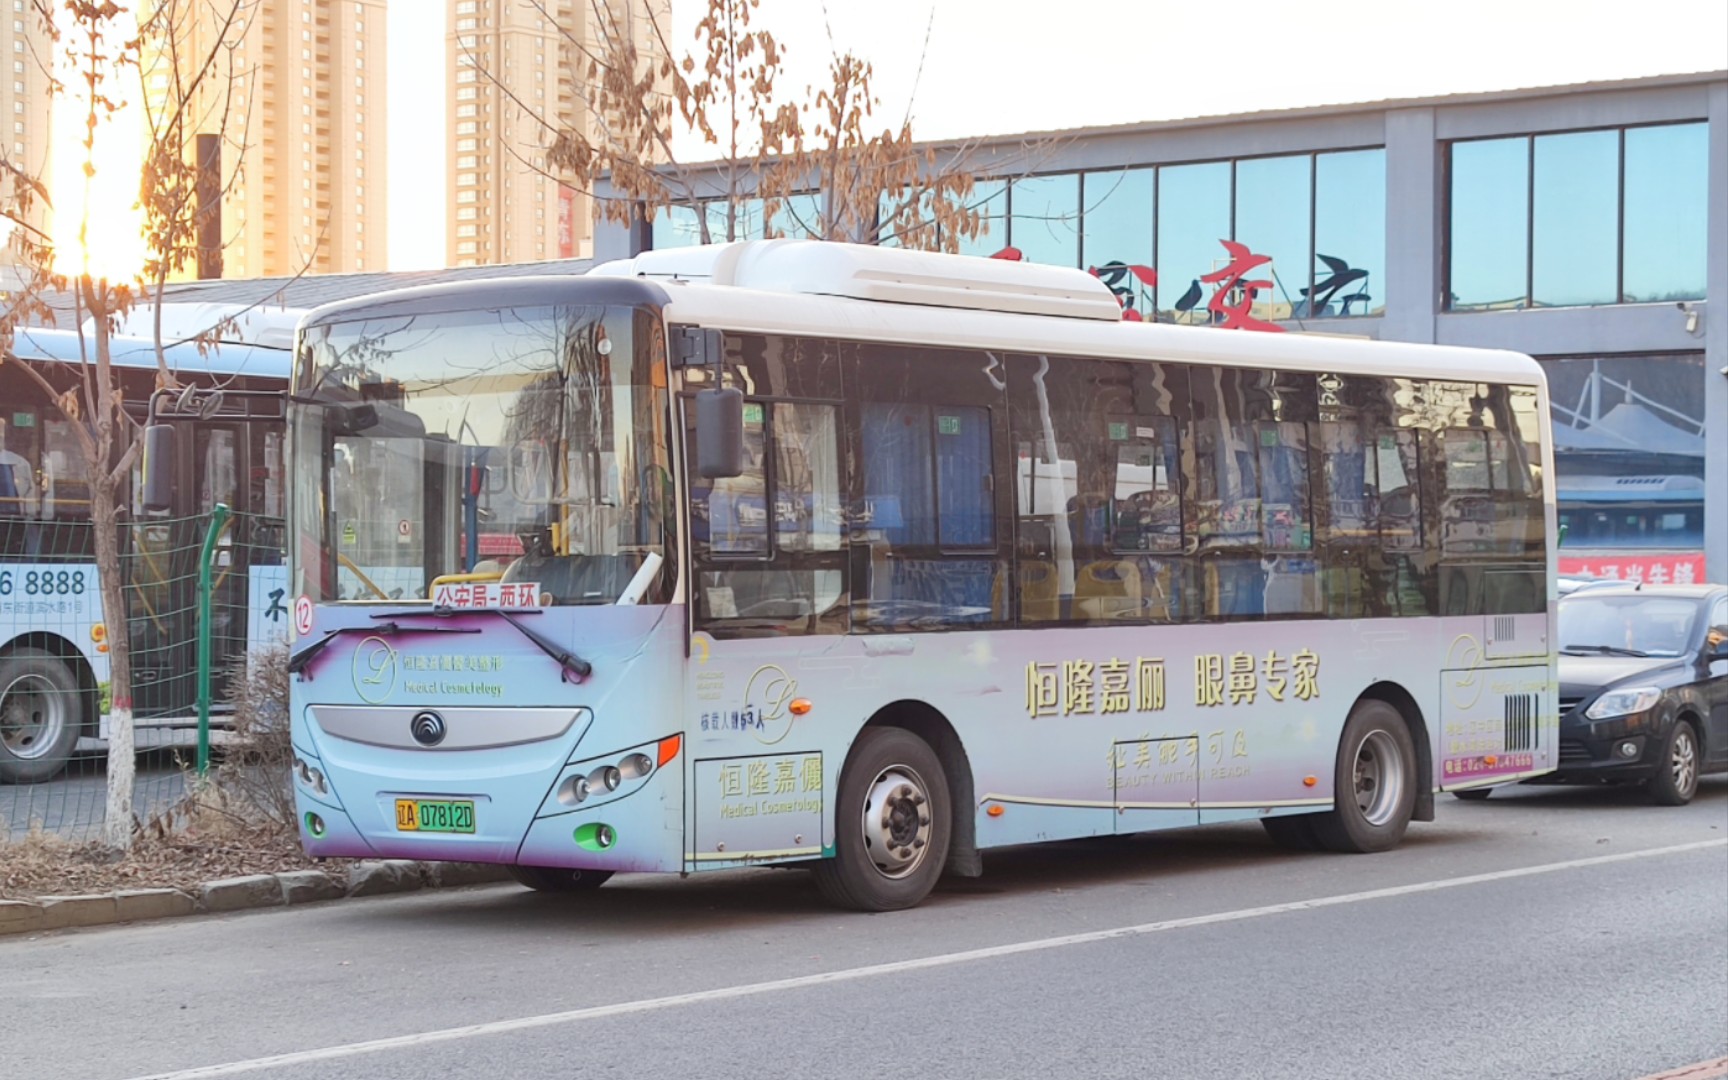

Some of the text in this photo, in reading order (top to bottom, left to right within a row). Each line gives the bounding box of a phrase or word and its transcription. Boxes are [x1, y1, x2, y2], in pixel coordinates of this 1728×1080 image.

[25, 571, 84, 595] 8888
[298, 603, 309, 629] 12
[403, 680, 438, 694] Medical
[1025, 648, 1320, 718] 恒隆嘉俪 眼鼻专家
[1106, 774, 1157, 789] BEAUTY
[1211, 764, 1251, 780] REACH
[720, 801, 758, 819] Medical
